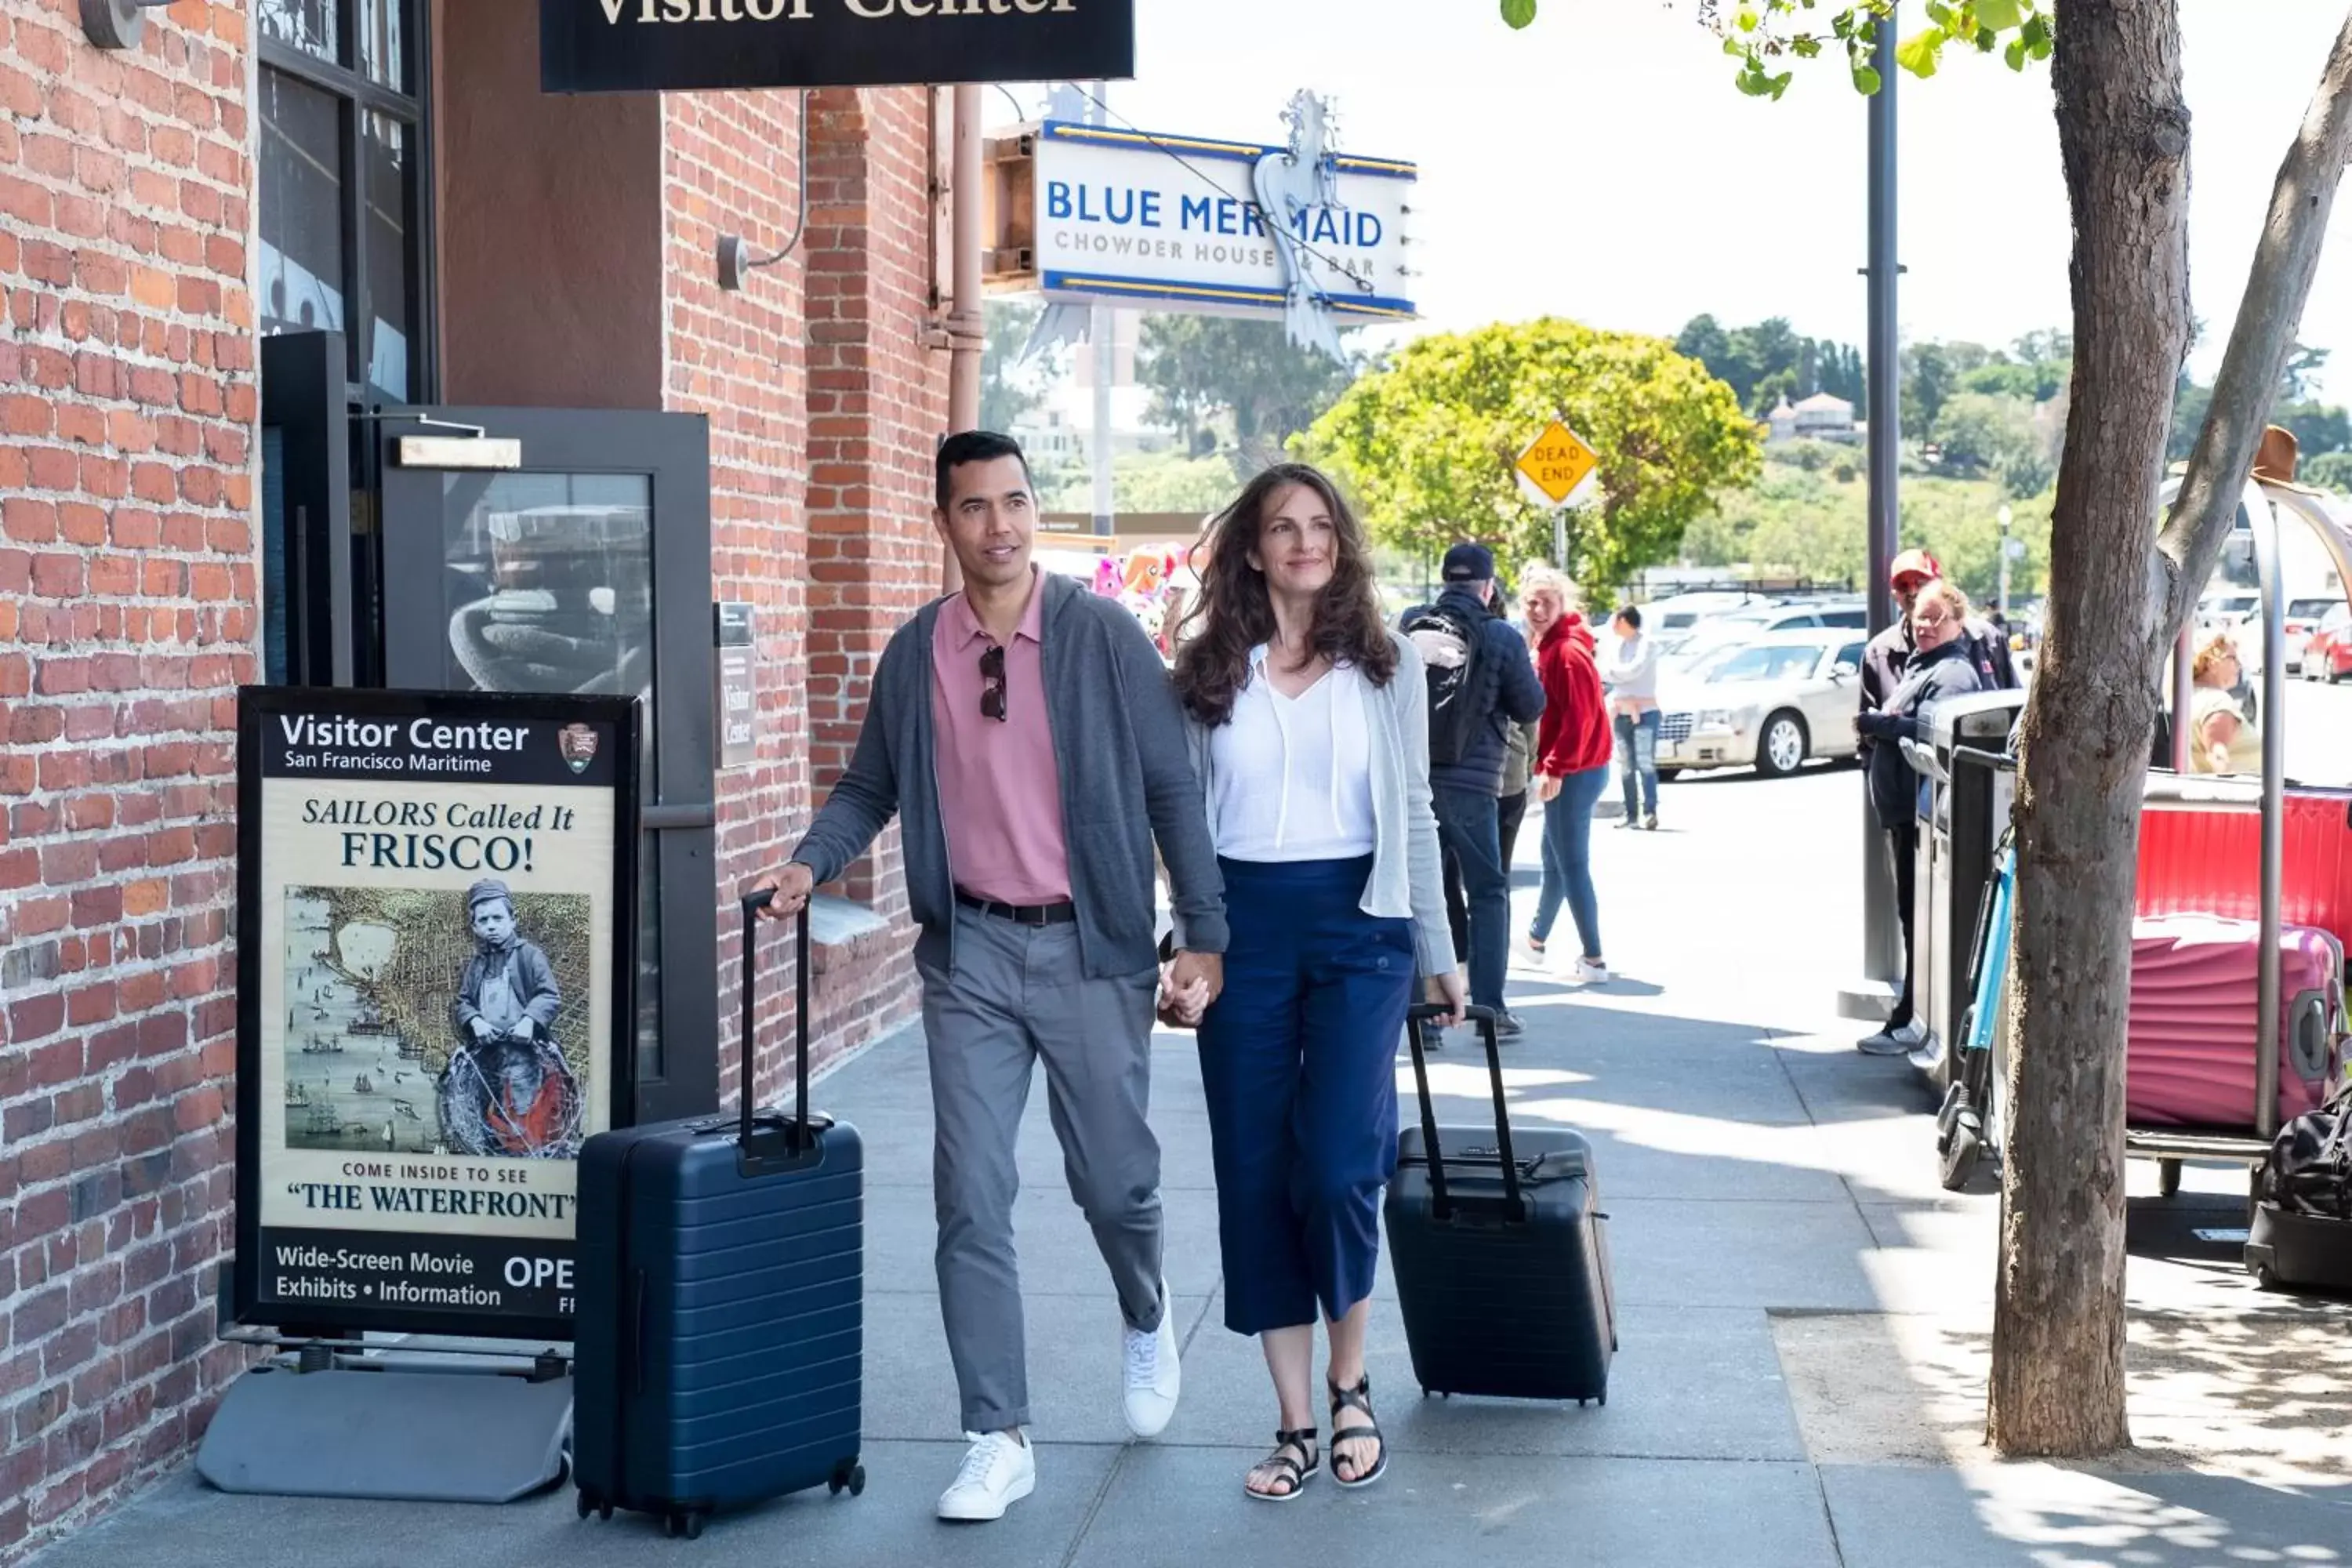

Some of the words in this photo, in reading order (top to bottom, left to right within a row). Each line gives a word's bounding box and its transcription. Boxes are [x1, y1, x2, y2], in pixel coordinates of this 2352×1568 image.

[1048, 182, 1160, 227] BLUE
[1054, 232, 1182, 260] CHOWDER
[1195, 245, 1274, 267] HOUSE
[1329, 256, 1374, 277] BAR
[1534, 445, 1579, 461] DEAD
[1541, 466, 1574, 482] END
[280, 714, 398, 747] Visitor
[409, 717, 529, 750] Center
[285, 751, 317, 768] San
[323, 752, 404, 770] Francisco
[409, 754, 492, 772] Maritime
[302, 799, 437, 827] SAILORS
[446, 803, 543, 829] Called
[550, 806, 575, 831] It
[341, 832, 532, 872] FRISCO!
[343, 1163, 391, 1178] COME
[401, 1165, 458, 1181] INSIDE
[466, 1167, 489, 1182] TO
[499, 1169, 527, 1183] SEE
[288, 1183, 361, 1210] “THE
[276, 1246, 403, 1271] Wide-Screen
[410, 1252, 474, 1274] Movie
[504, 1257, 574, 1289] OPE
[277, 1276, 357, 1299] Exhibits
[380, 1280, 501, 1305] Information
